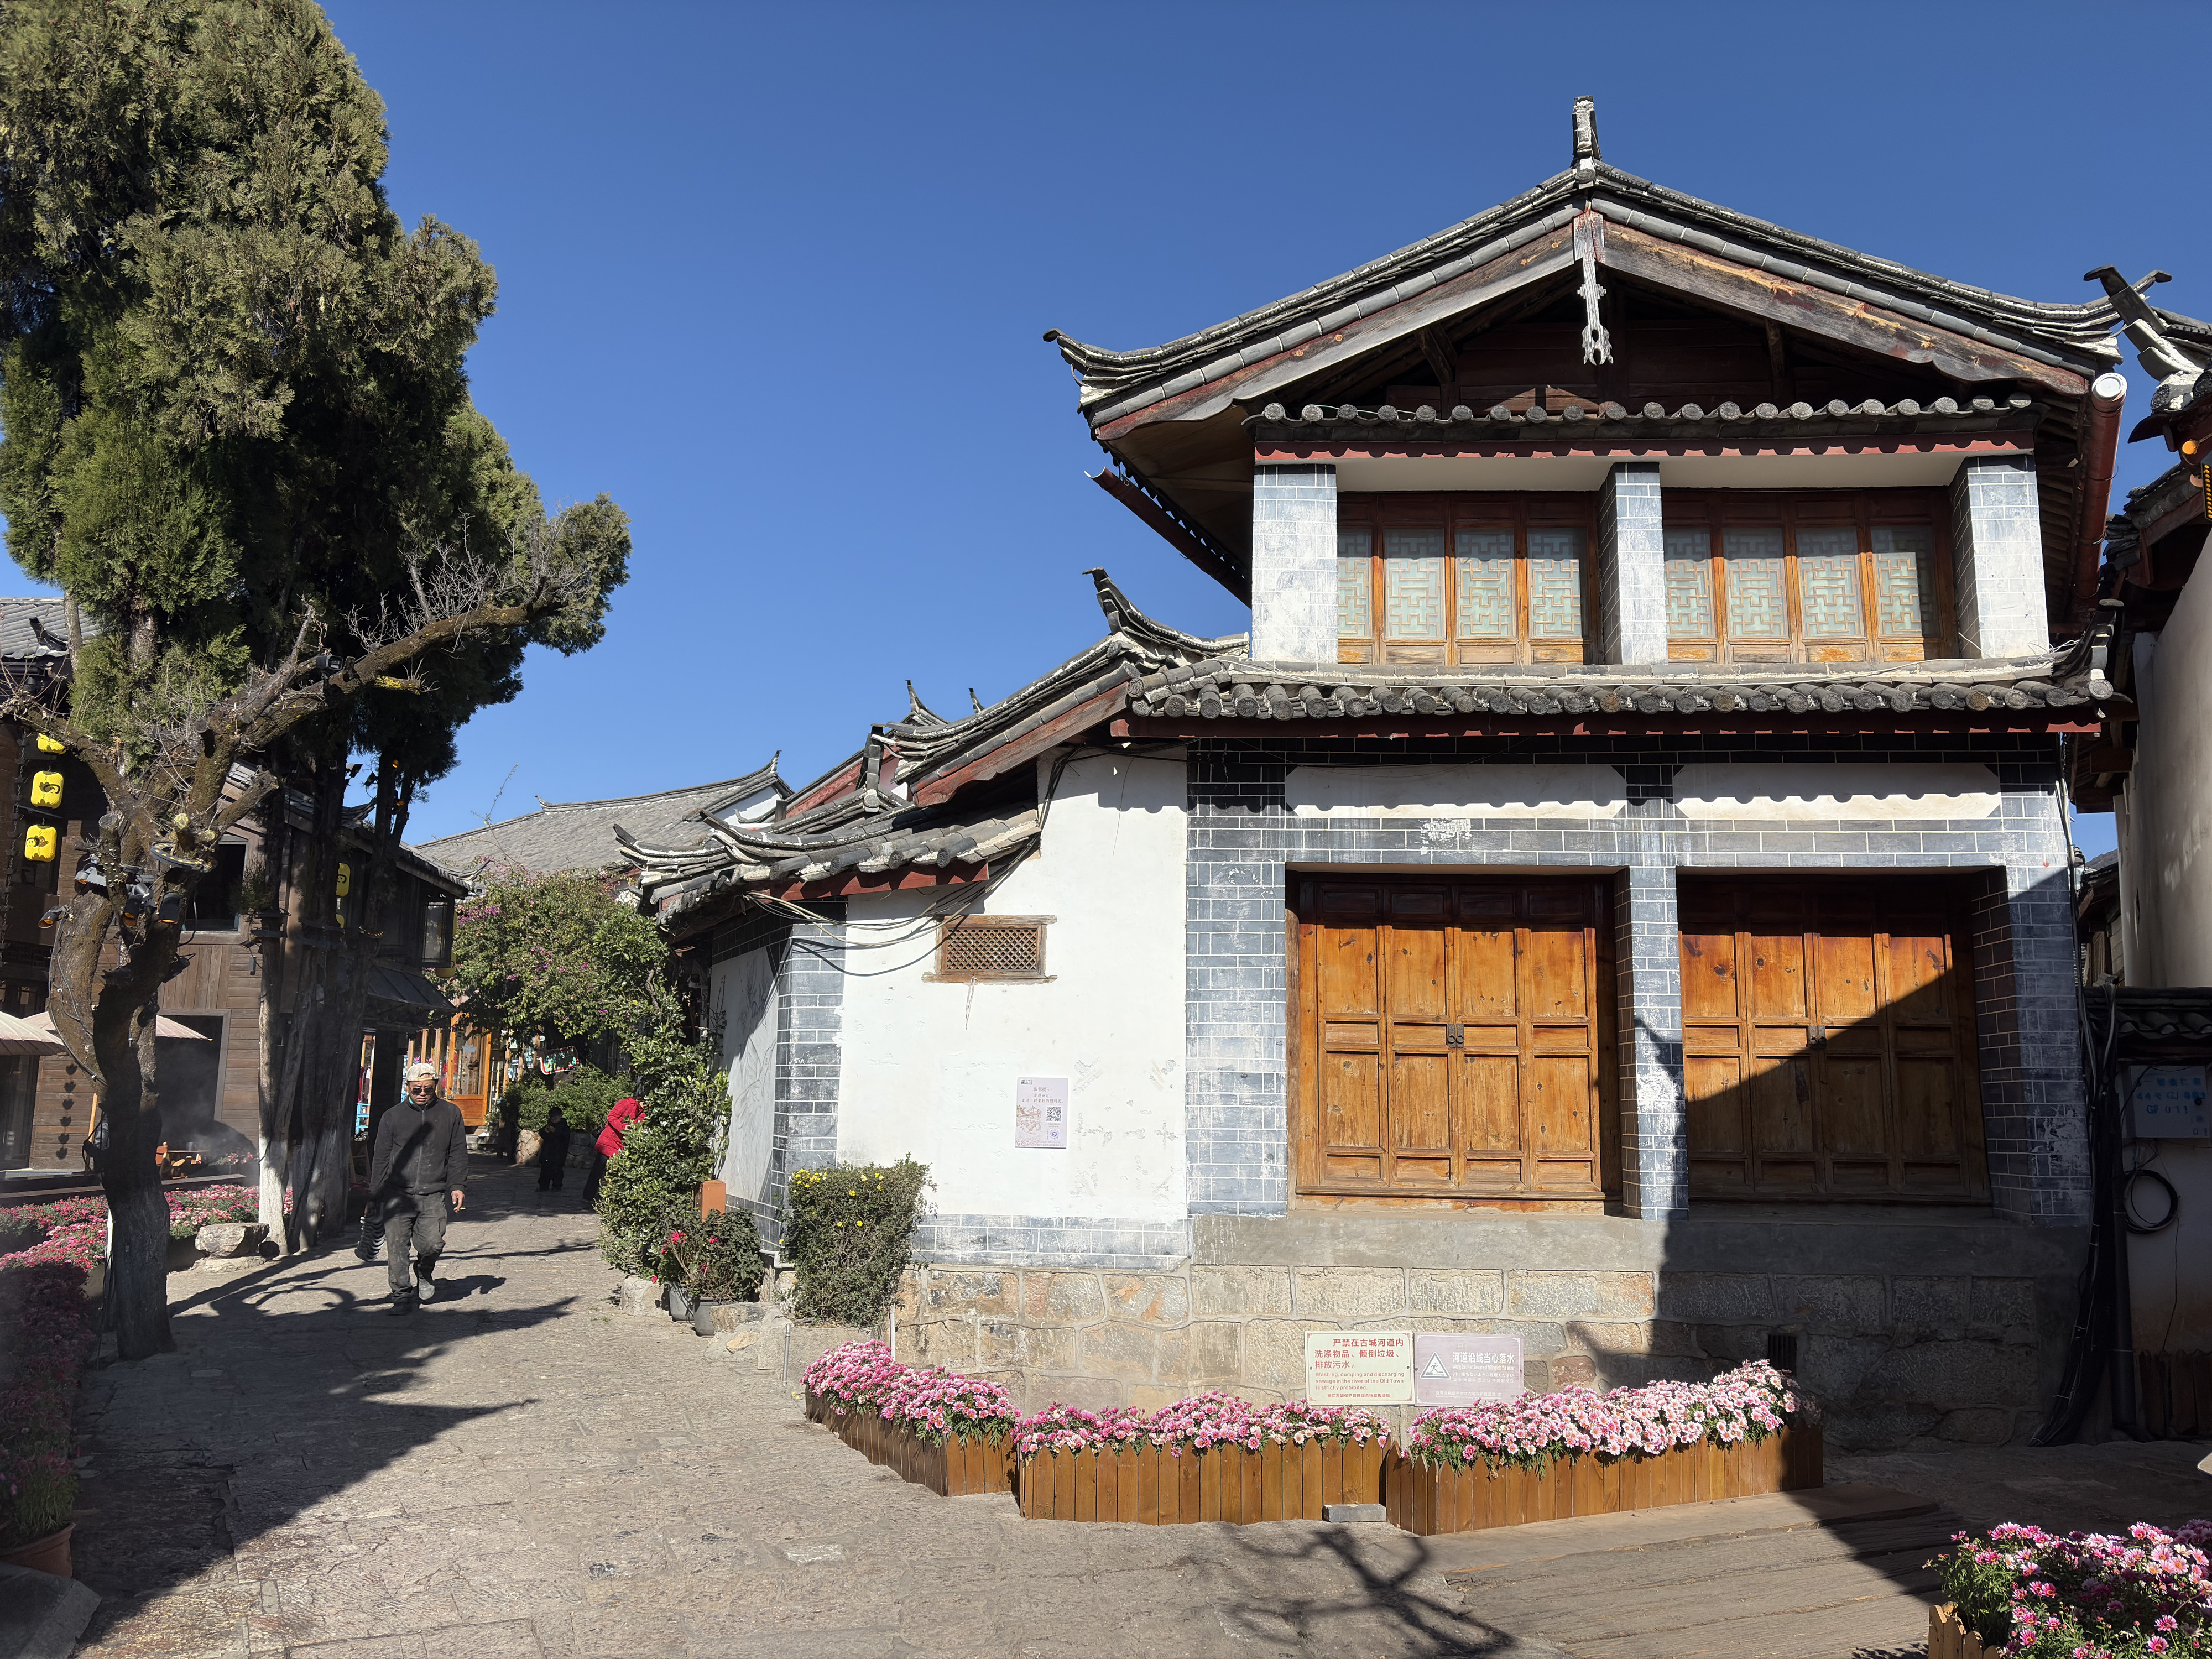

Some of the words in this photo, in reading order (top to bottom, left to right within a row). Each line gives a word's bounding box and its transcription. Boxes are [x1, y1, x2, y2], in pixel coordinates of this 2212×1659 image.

[1333, 1338, 1404, 1347] 严禁在古城河道内
[1453, 1352, 1515, 1364] 河道沿线当心落水
[1315, 1360, 1355, 1369] 排放污水。
